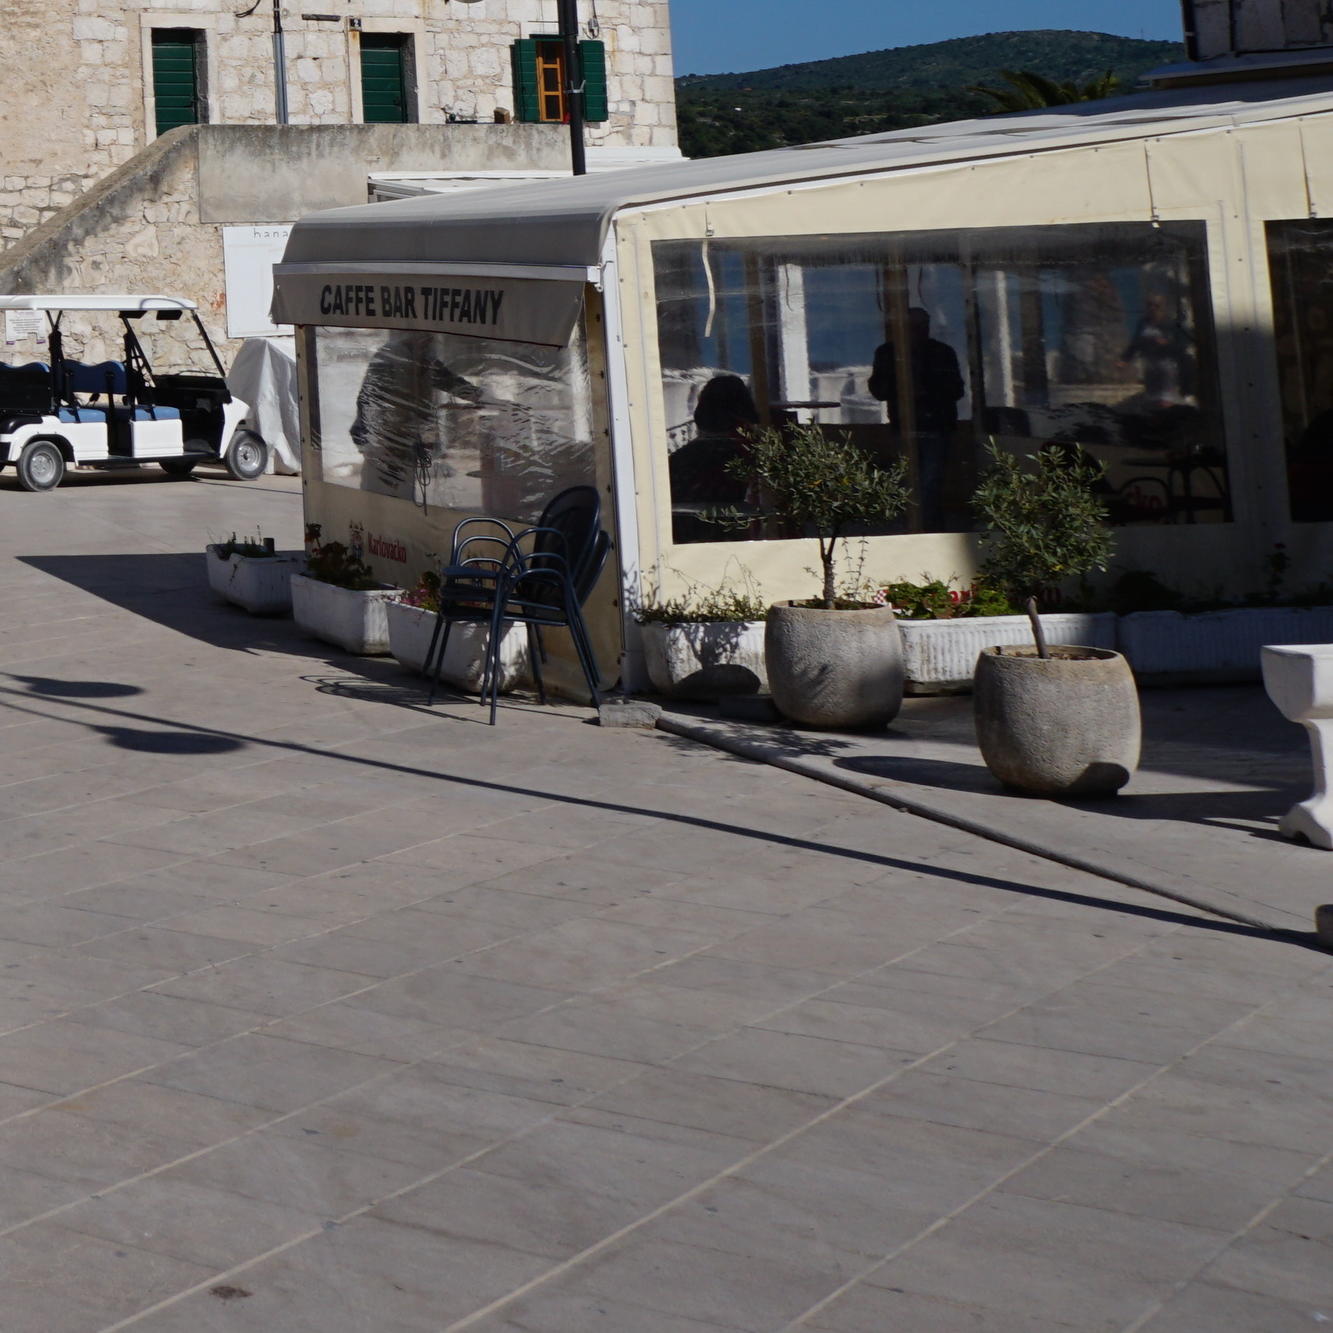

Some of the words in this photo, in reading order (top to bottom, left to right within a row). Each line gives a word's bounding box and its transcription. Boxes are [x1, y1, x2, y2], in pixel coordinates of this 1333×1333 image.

[320, 284, 376, 316] CAFFE
[380, 285, 417, 319] BAR
[421, 286, 504, 325] TIFFANY
